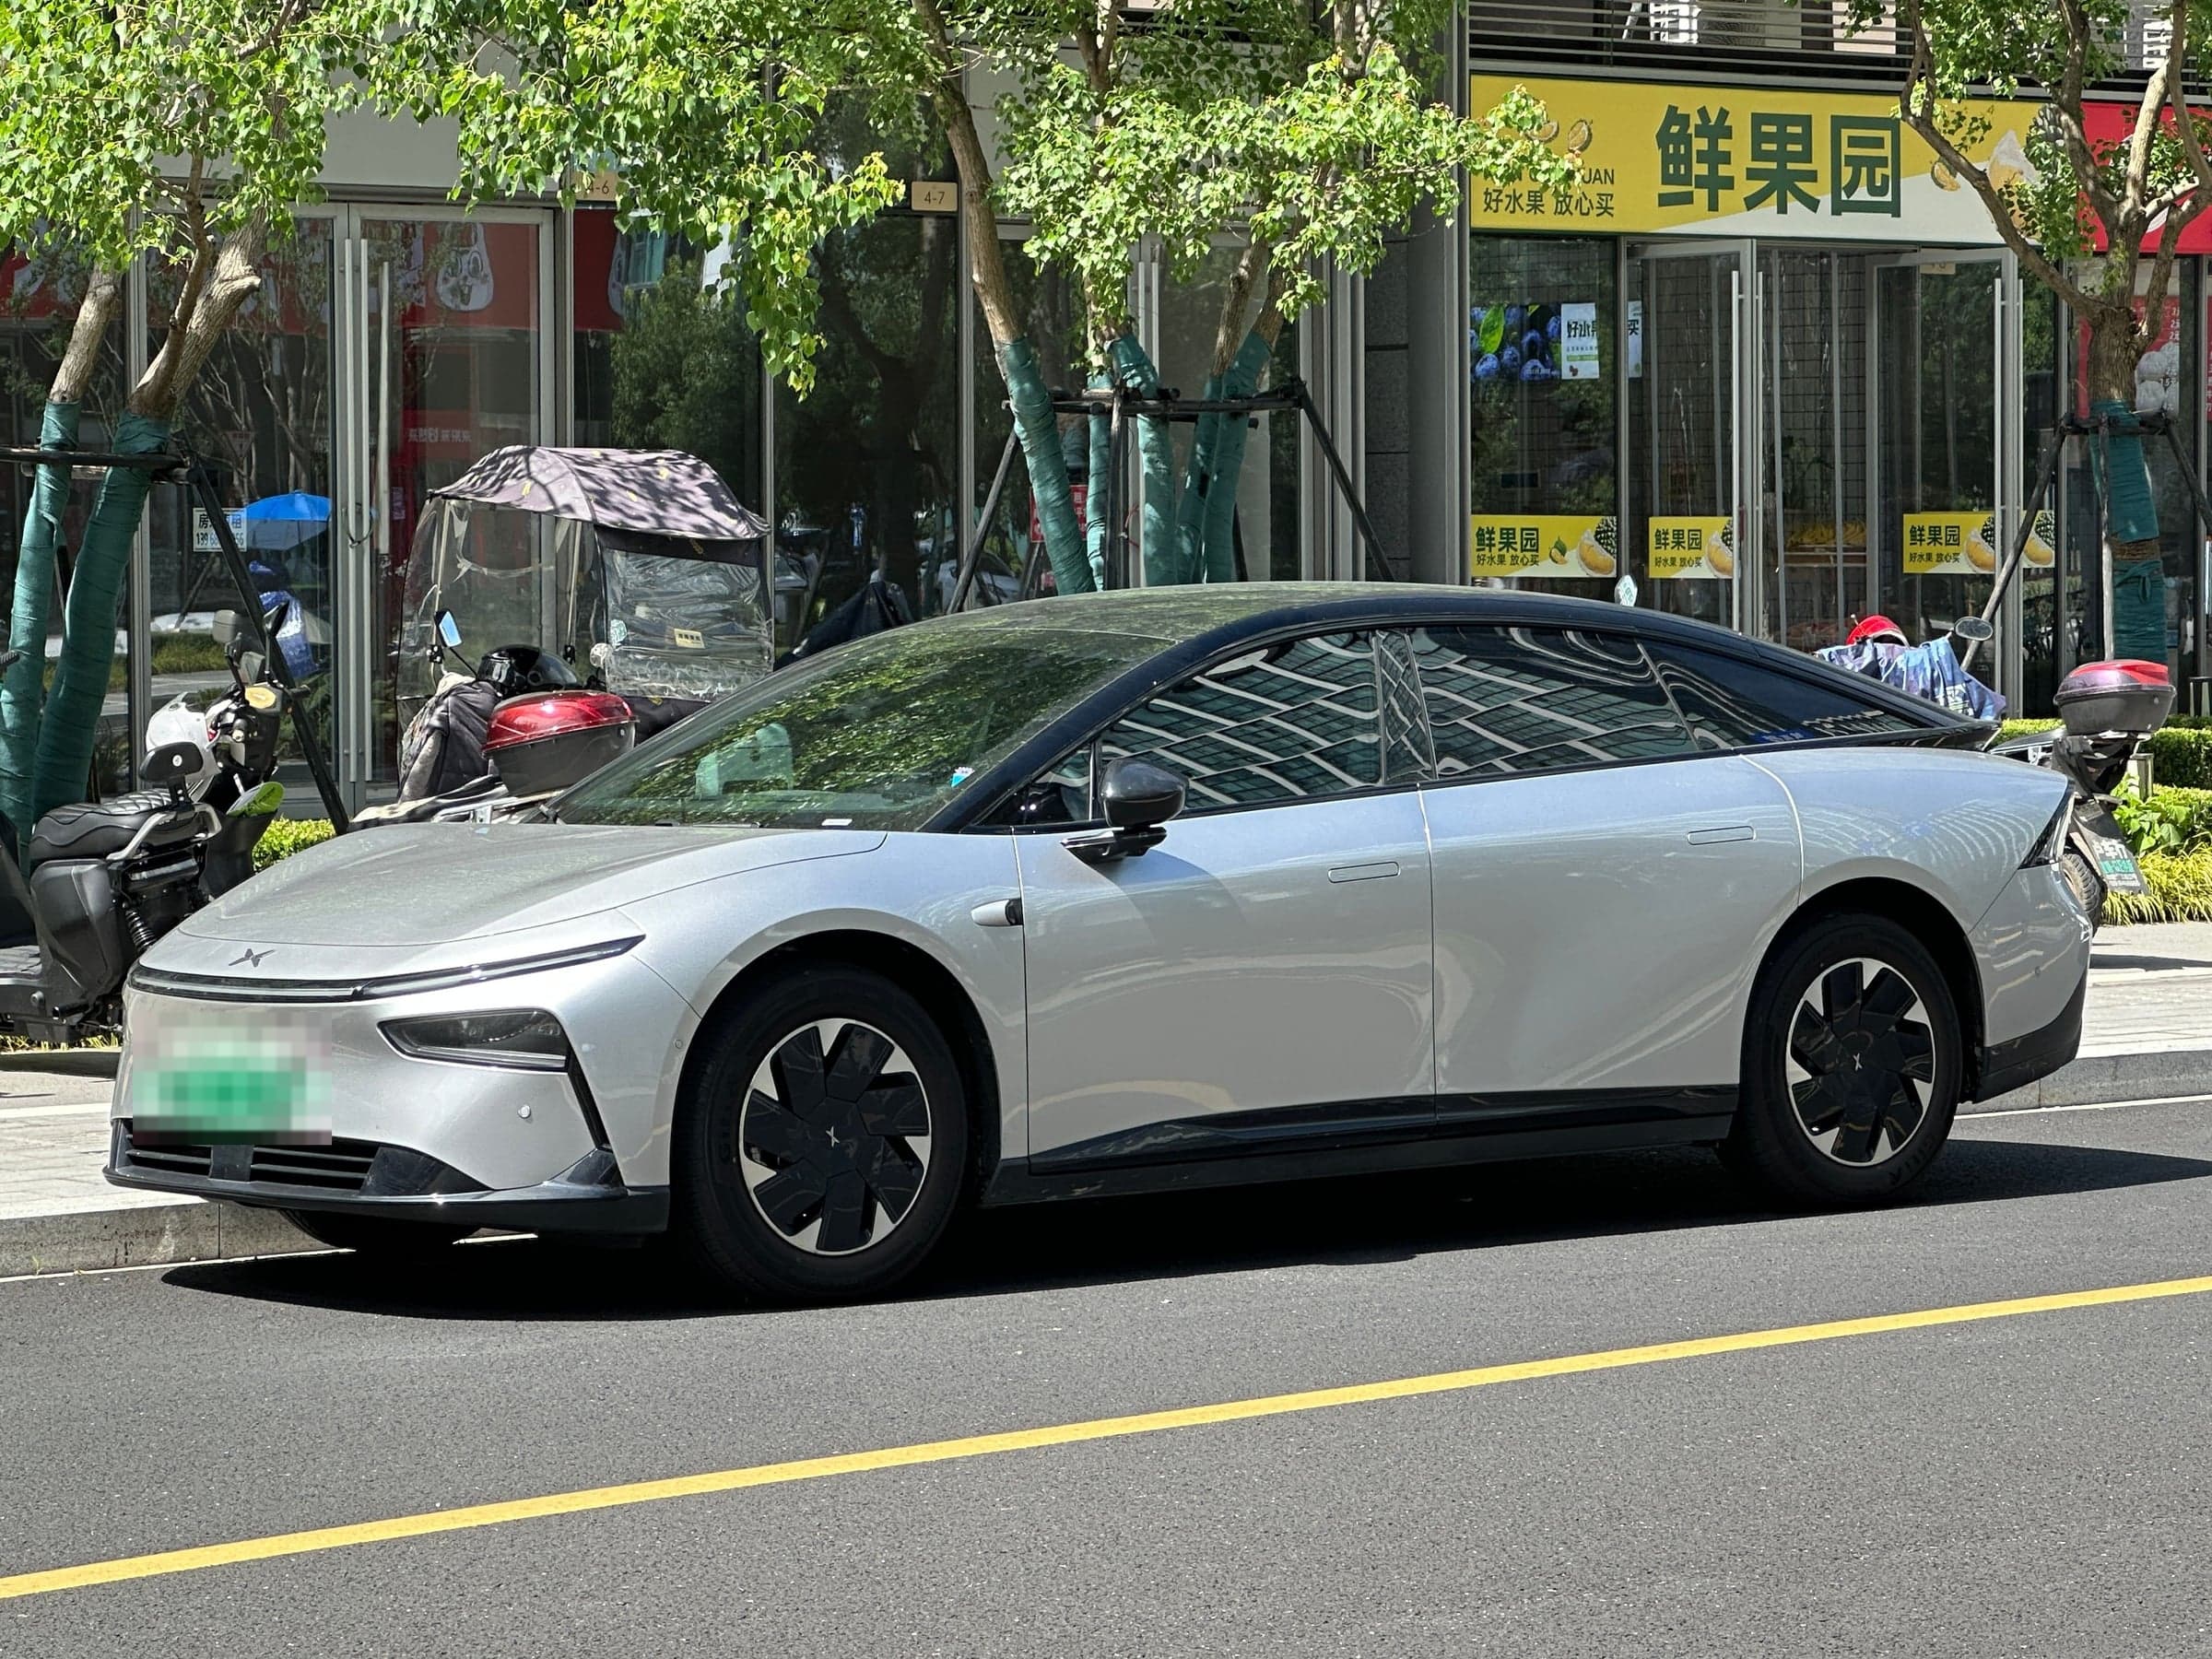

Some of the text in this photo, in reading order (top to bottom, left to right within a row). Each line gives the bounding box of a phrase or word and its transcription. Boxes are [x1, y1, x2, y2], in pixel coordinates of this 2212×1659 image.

[1655, 104, 1901, 218] 鲜果园
[924, 190, 946, 205] 4-7
[1483, 187, 1615, 218] 好水果 放心买
[1476, 525, 1539, 553] 鲜果园
[1654, 528, 1702, 550] 鲜果园
[1909, 524, 1960, 547] 鲜果园
[1477, 554, 1540, 566] 好水果 放心买
[1654, 556, 1702, 568] 好水果 放心买
[1909, 552, 1960, 563] 好水果 放心买
